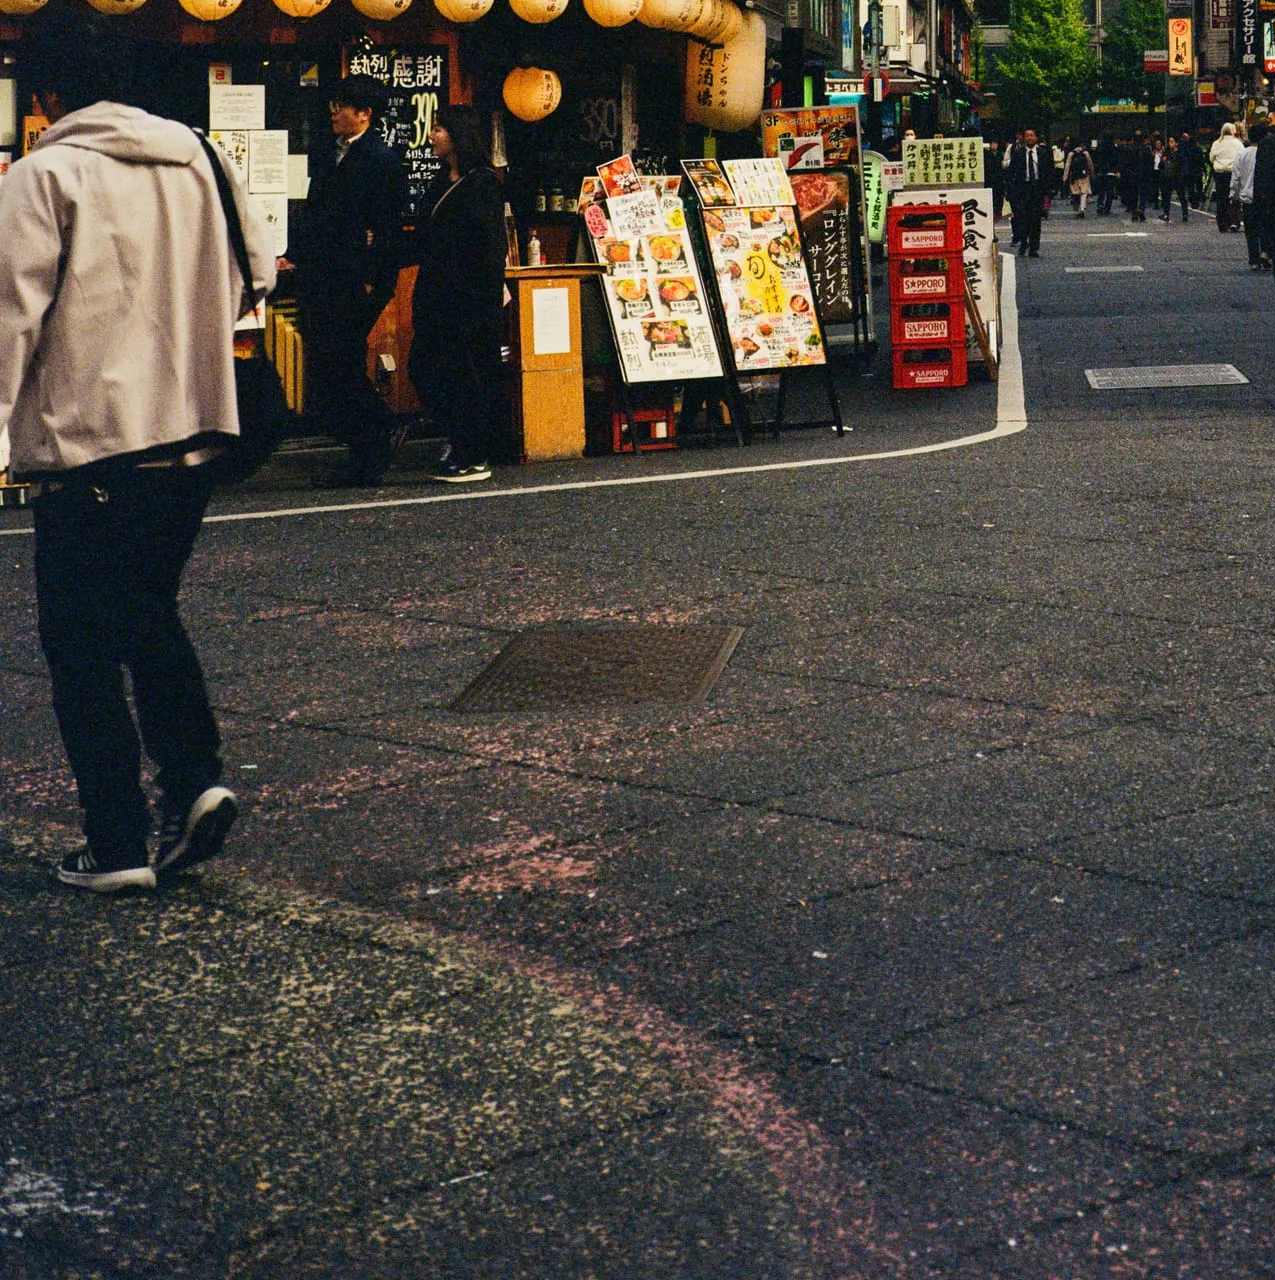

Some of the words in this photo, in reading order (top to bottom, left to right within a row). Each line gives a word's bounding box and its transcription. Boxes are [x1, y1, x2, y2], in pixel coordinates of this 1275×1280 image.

[766, 117, 778, 127] 3F
[911, 235, 943, 243] SAPPORO
[906, 322, 946, 332] SAPPORO
